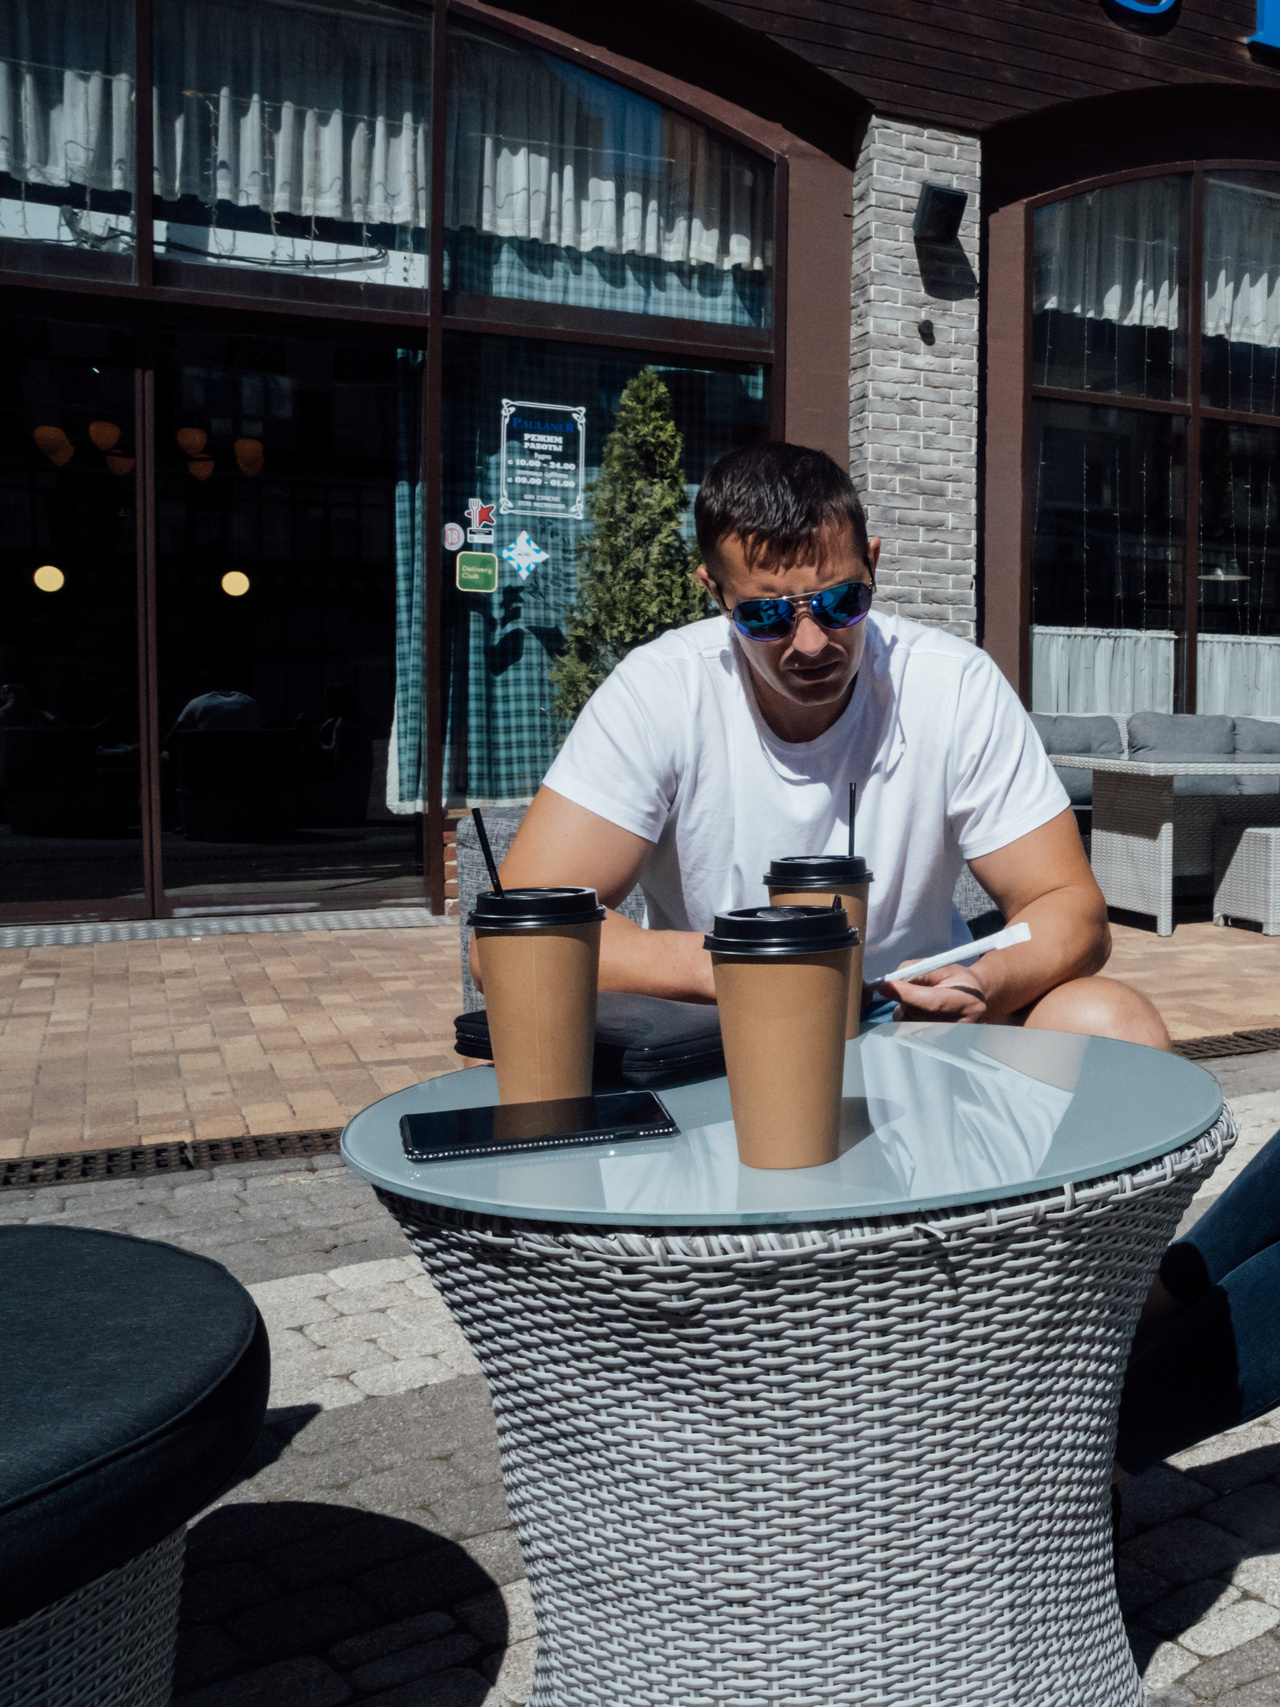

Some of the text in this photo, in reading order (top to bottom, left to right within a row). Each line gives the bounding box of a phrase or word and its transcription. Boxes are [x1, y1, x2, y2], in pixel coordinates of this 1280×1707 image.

[512, 417, 575, 433] PAULANER
[523, 433, 563, 444] РЕЖИМ
[523, 442, 563, 452] РАБОТЫ
[515, 459, 541, 468] 10.00
[550, 462, 575, 470] 24.00
[446, 529, 459, 544] 18
[462, 565, 493, 575] Delivery
[462, 572, 479, 580] Club
